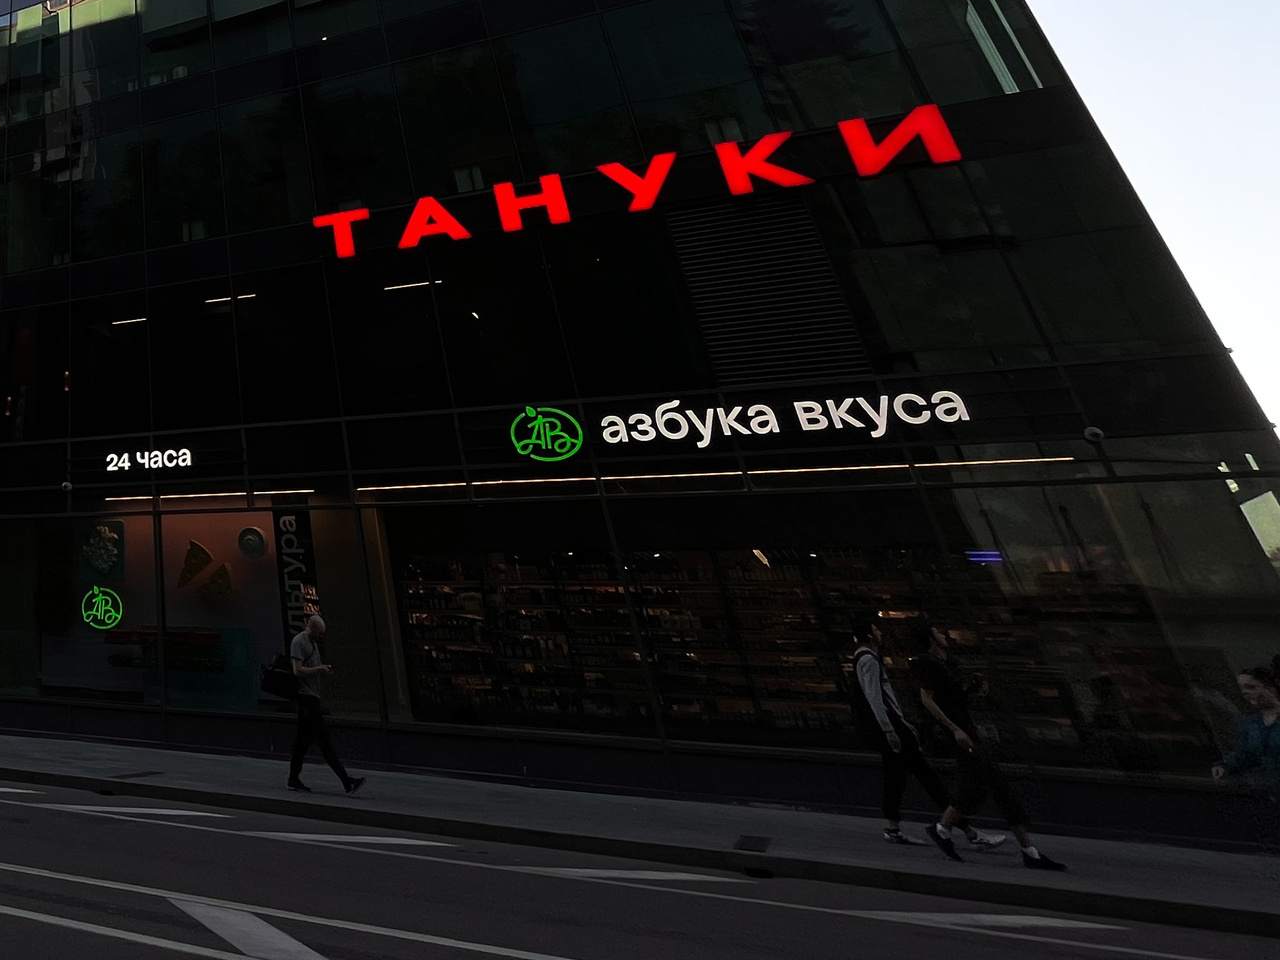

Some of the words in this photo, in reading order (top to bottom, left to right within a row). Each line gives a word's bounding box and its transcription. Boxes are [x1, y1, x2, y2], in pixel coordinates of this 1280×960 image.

[312, 104, 961, 258] ТАНУКИ
[105, 452, 132, 471] 24
[135, 448, 192, 469] часа
[600, 399, 780, 448] азбука
[793, 390, 971, 438] вкуса
[279, 515, 306, 635] льтура
